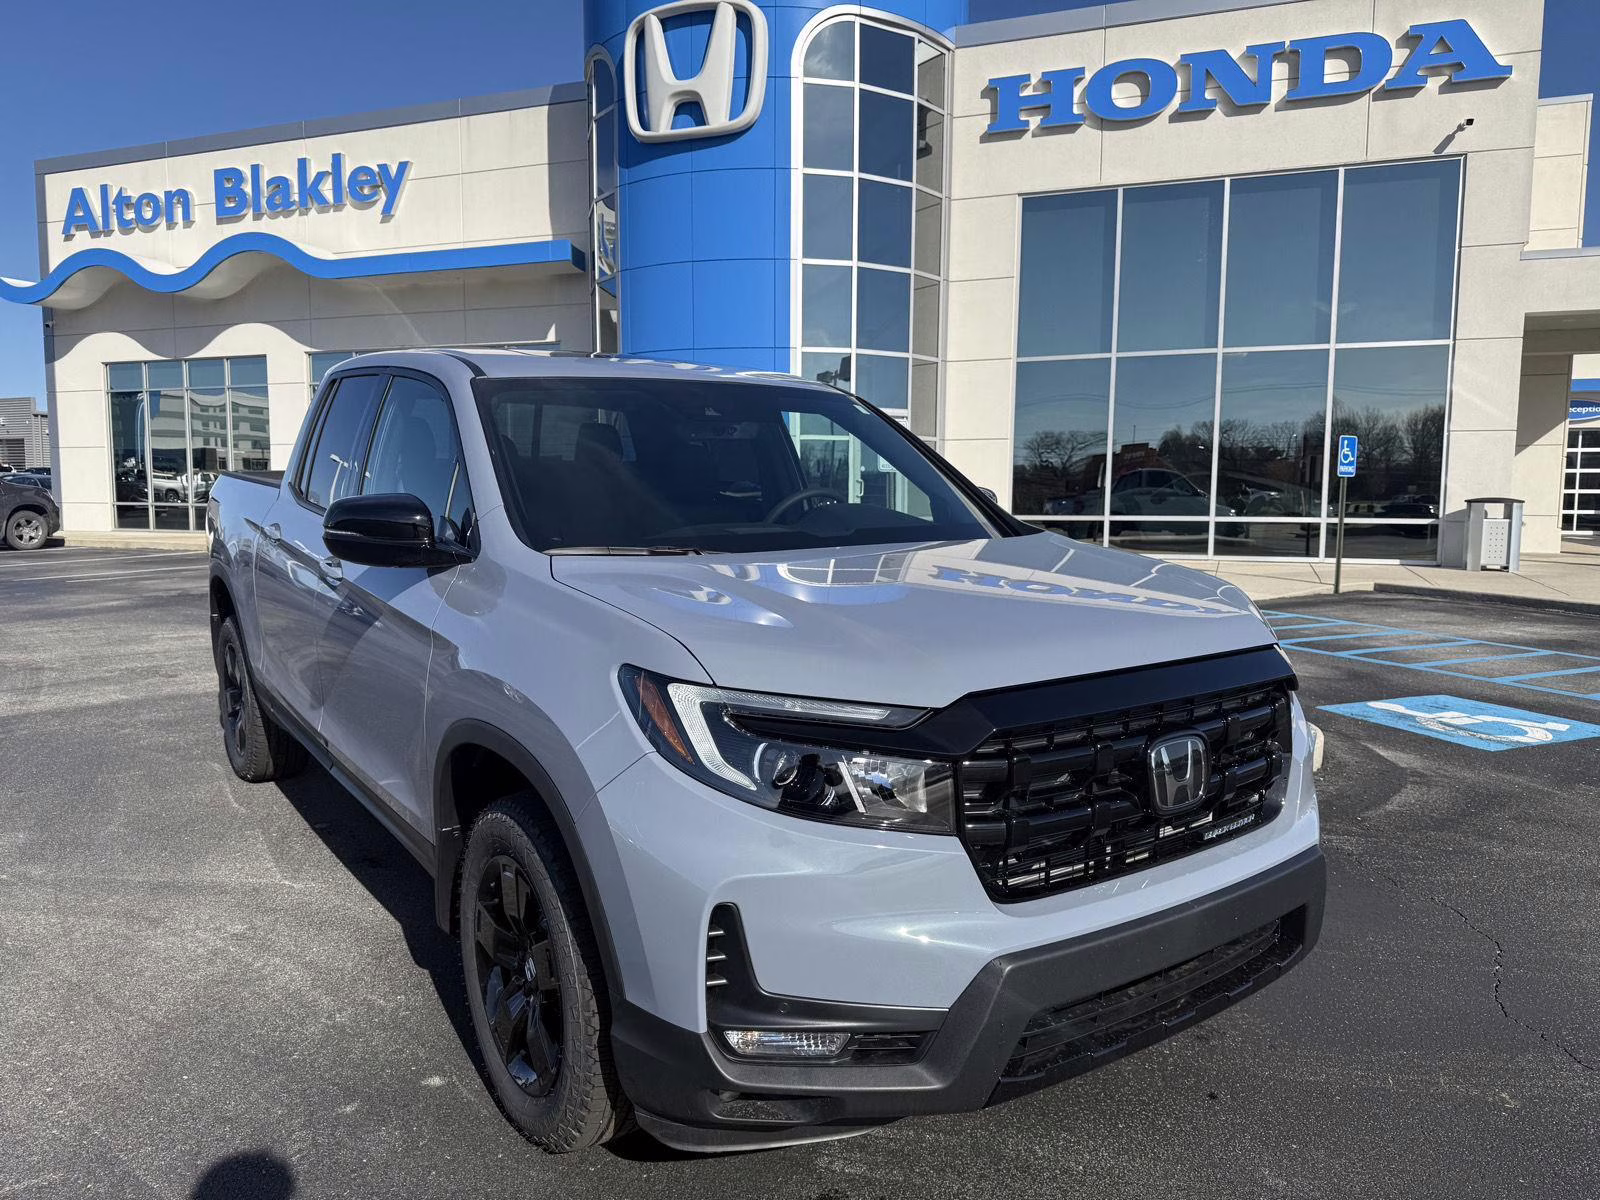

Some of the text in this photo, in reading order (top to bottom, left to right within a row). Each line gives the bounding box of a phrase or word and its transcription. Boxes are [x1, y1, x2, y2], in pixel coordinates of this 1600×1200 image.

[986, 18, 1513, 135] HONDA
[62, 152, 412, 237] Alton Blakley
